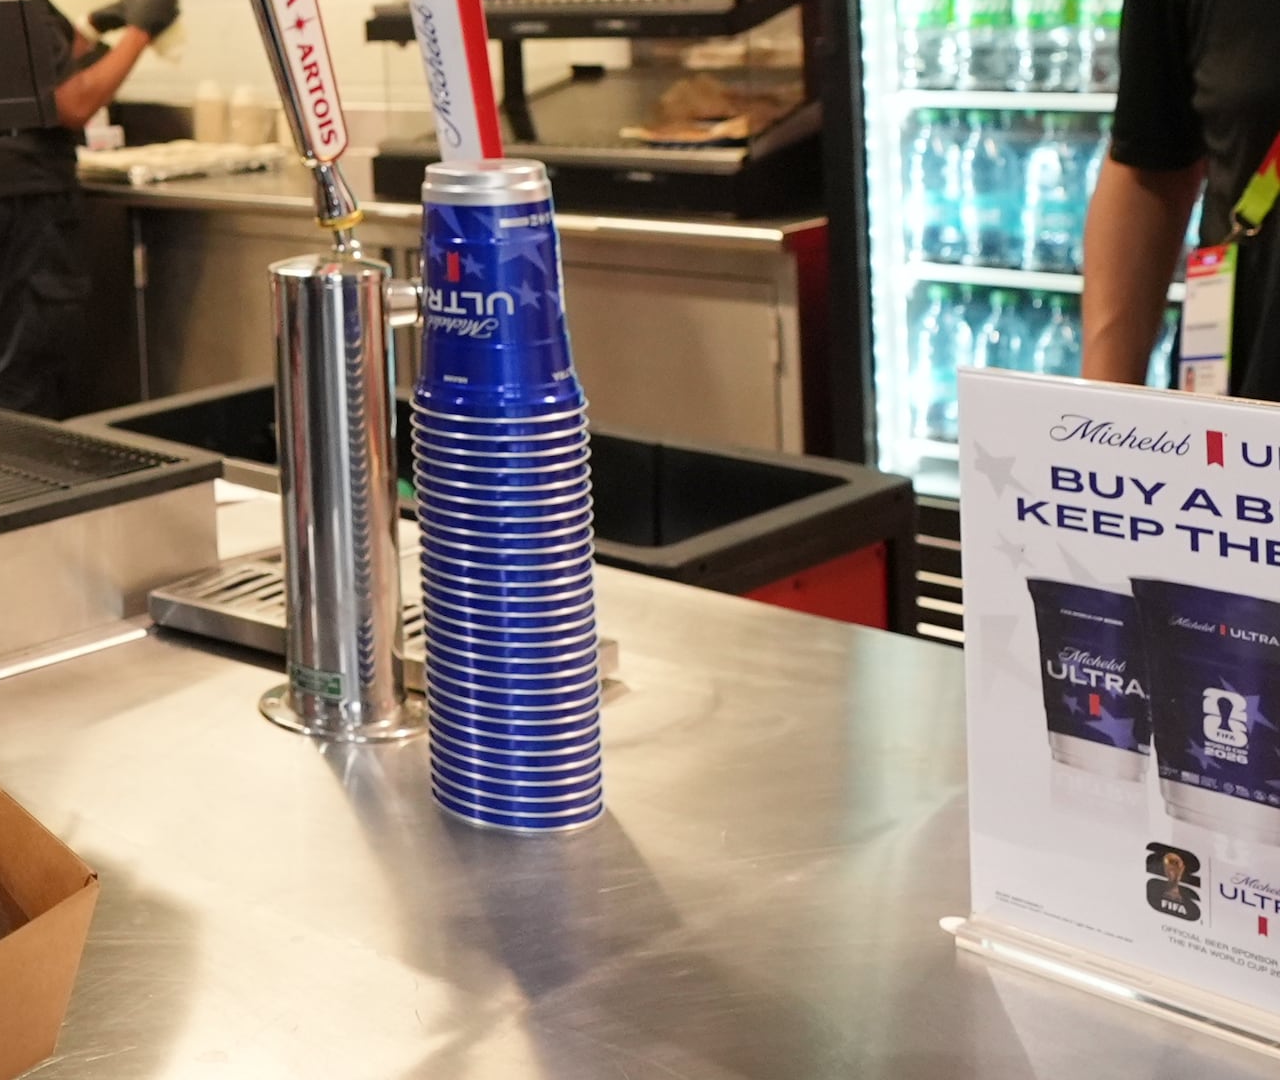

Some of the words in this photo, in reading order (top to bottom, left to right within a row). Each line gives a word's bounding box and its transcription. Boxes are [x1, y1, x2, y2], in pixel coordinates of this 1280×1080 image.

[296, 42, 340, 146] ARTOIS
[1049, 413, 1192, 457] Michelob
[1051, 465, 1167, 506] BUY
[1180, 487, 1223, 518] A
[1017, 497, 1165, 542] KEEP
[1230, 627, 1280, 648] ULTRA
[1047, 659, 1146, 700] ULTRA
[1058, 646, 1127, 673] Michelob
[1161, 899, 1188, 916] FIFA
[1204, 937, 1229, 952] BEER
